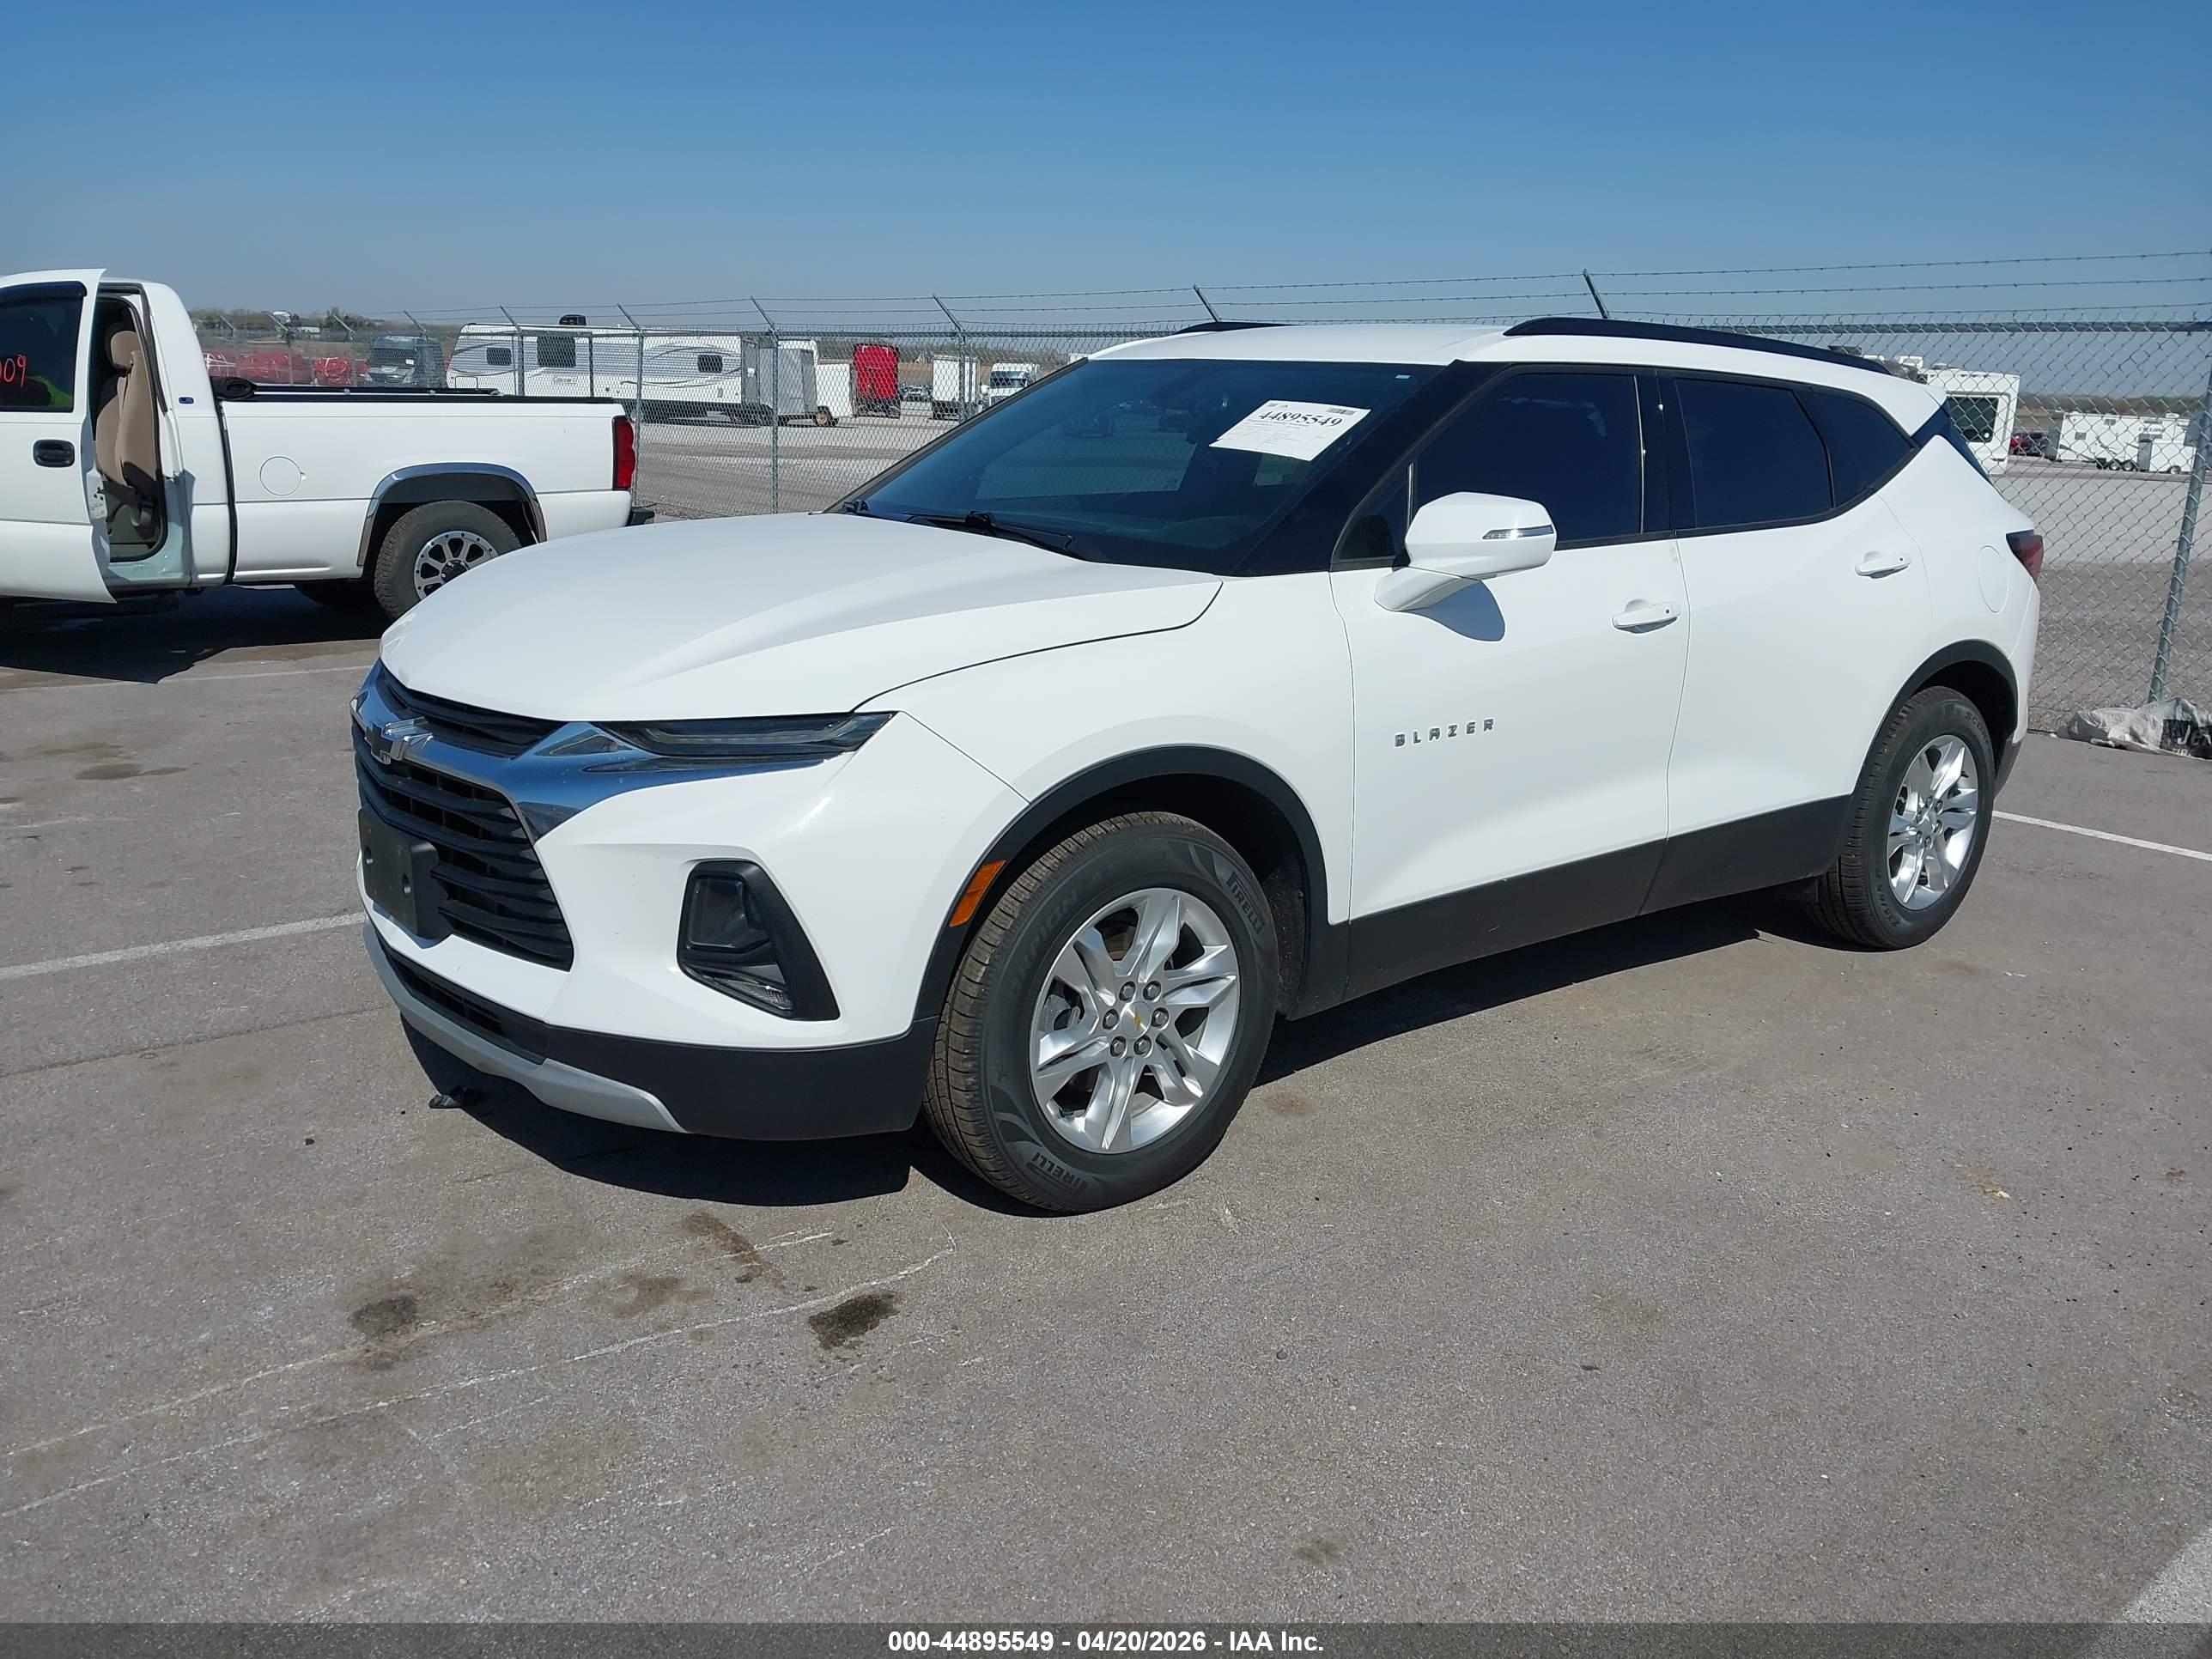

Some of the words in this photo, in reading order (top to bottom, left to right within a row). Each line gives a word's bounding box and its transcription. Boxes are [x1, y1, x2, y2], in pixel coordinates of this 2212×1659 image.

[0, 354, 27, 387] 09
[1258, 410, 1343, 427] 44895549
[1395, 719, 1494, 747] BLAZER
[1224, 870, 1267, 935] PIRELLI
[1025, 1151, 1089, 1197] PIRELLI
